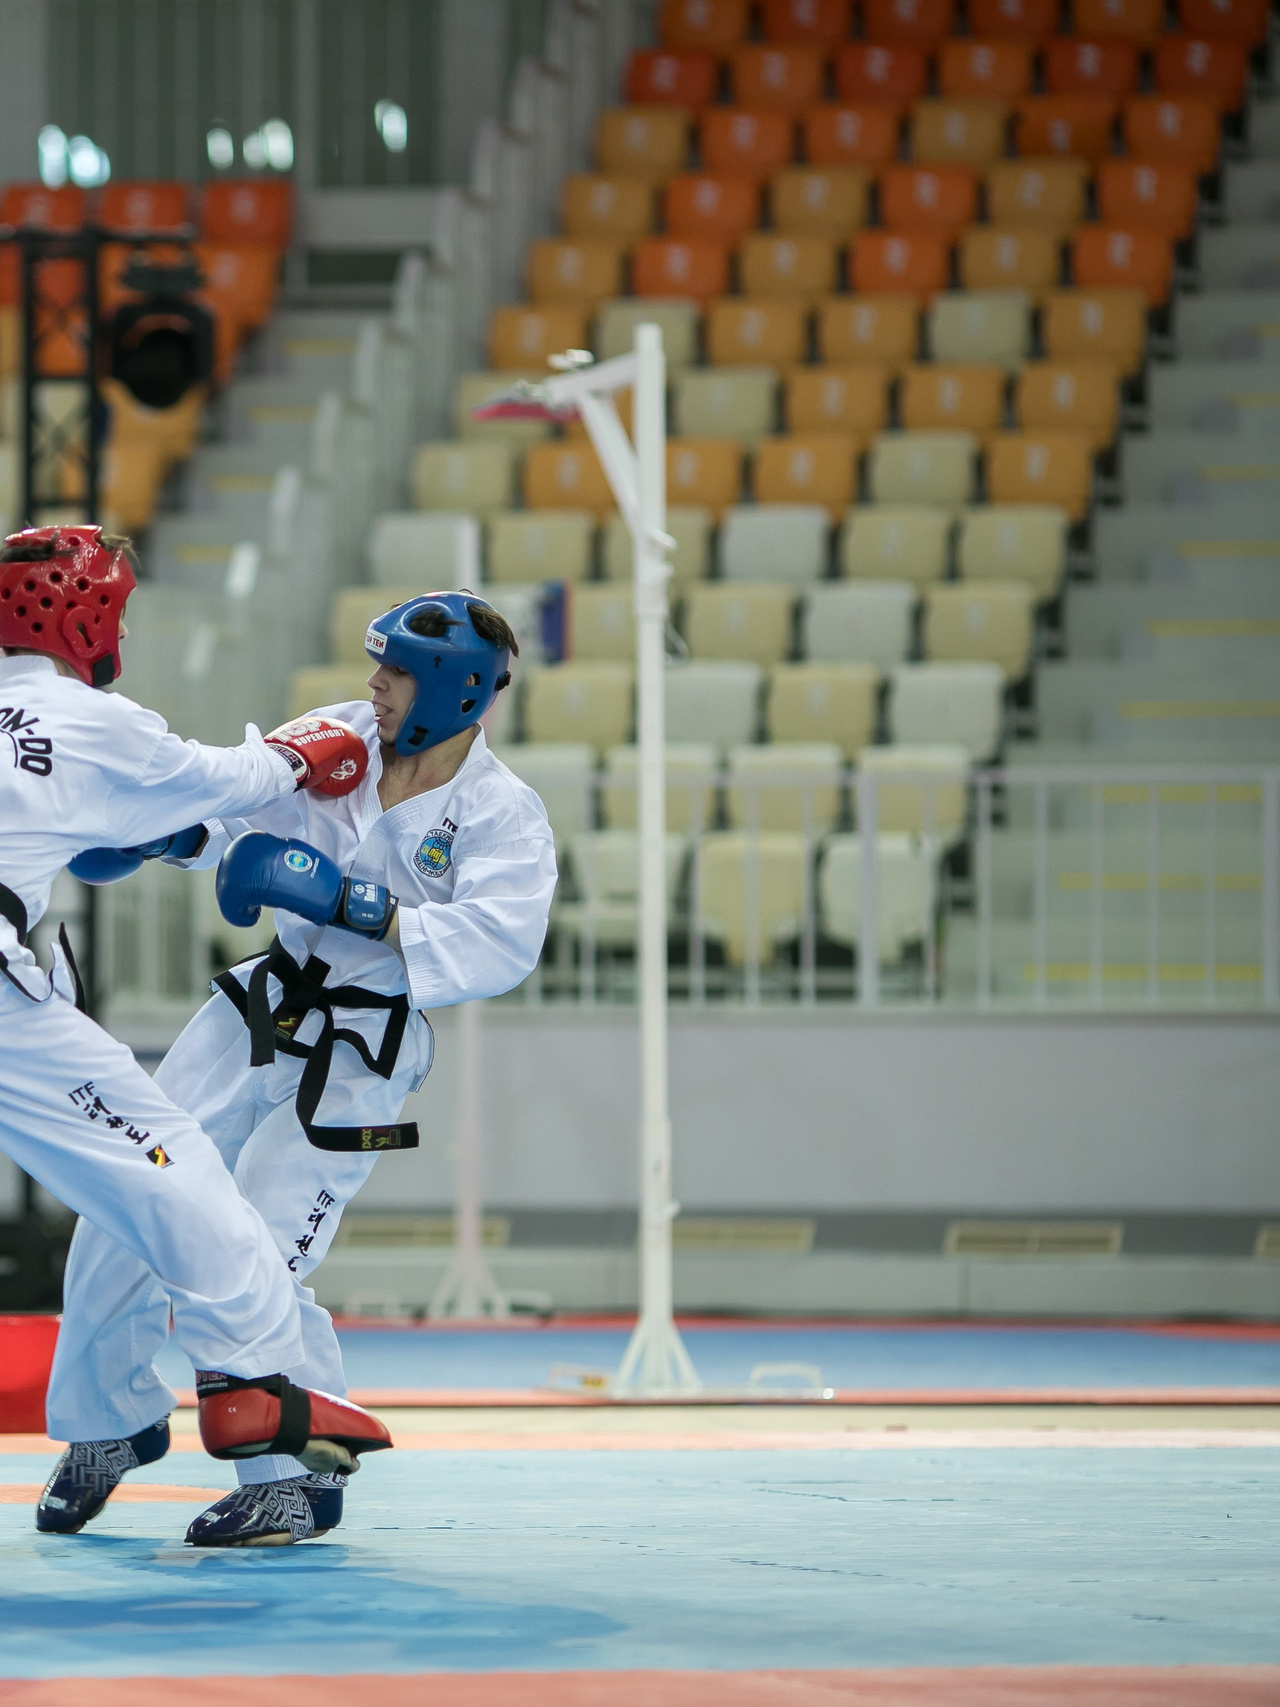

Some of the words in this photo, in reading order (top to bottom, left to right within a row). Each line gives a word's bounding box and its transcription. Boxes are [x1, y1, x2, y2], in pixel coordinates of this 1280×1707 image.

[293, 728, 346, 746] SUPERFIGHT
[442, 816, 459, 834] ITF
[67, 1081, 95, 1106] ITF
[316, 1189, 336, 1209] ITF
